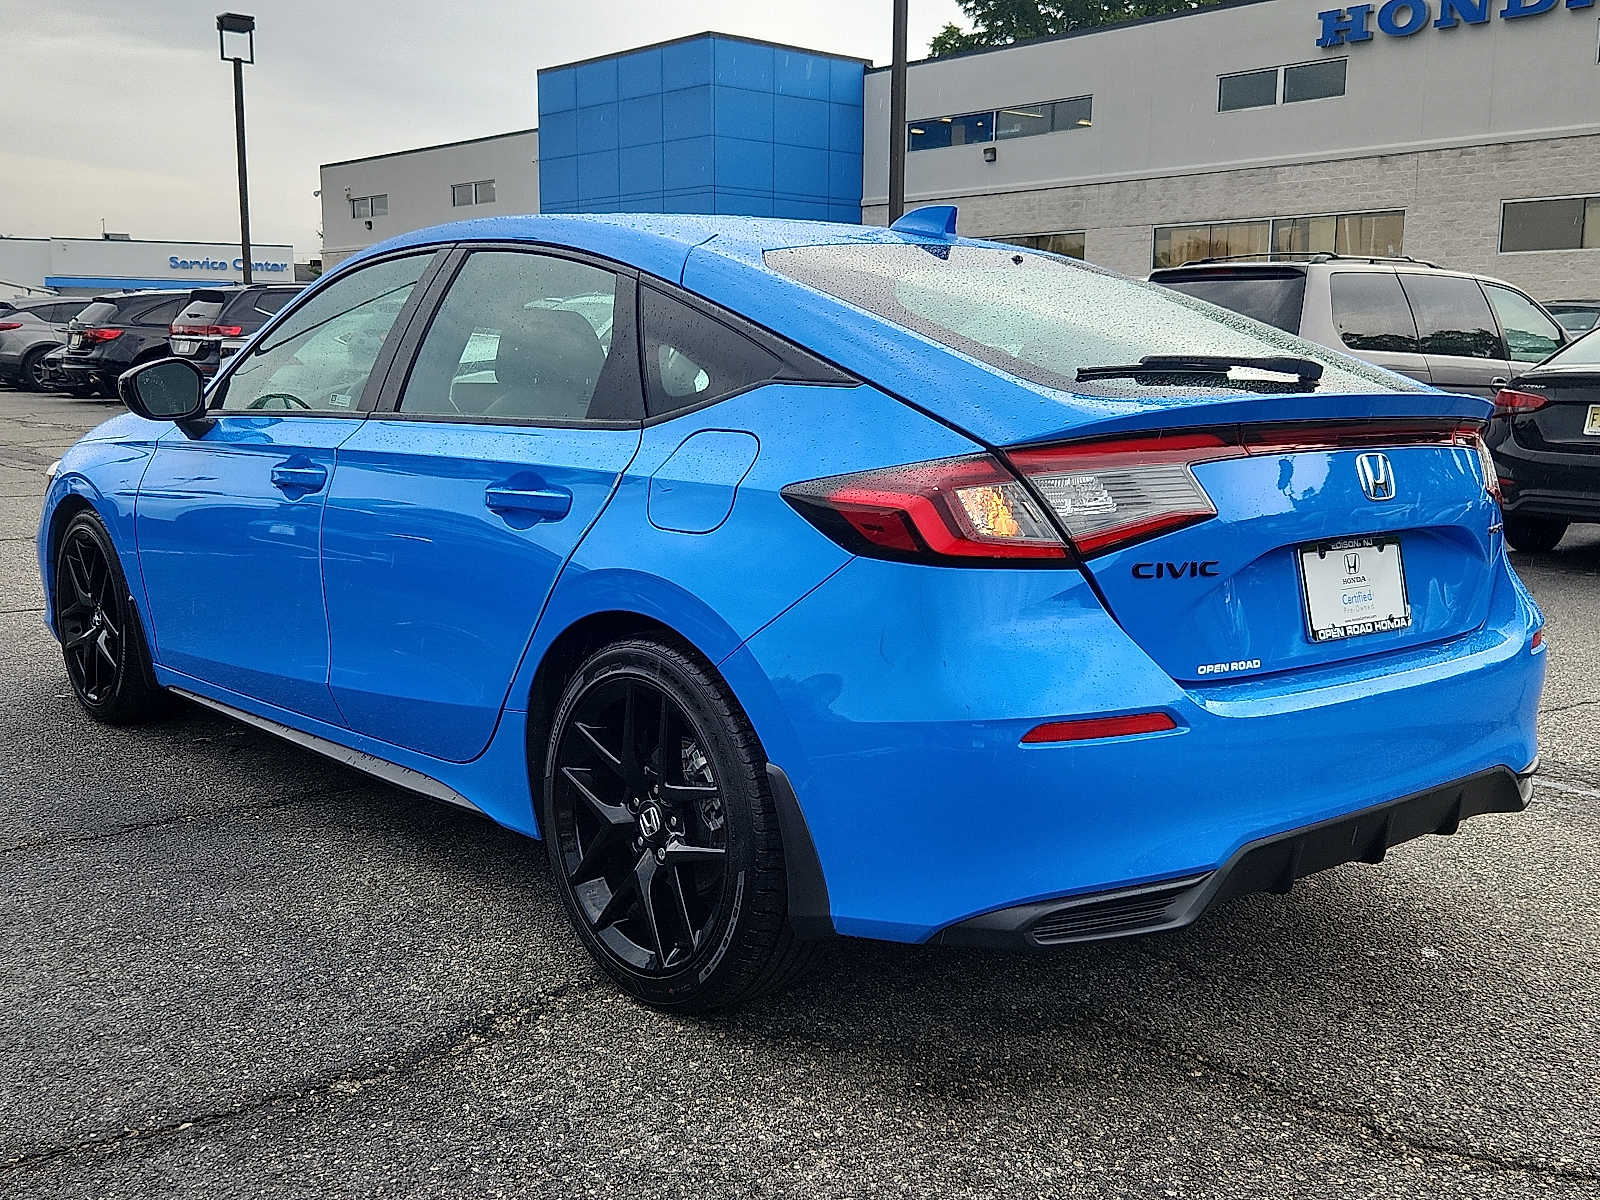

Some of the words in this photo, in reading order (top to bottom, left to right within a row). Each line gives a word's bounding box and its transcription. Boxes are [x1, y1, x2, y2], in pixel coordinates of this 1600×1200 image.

[1315, 0, 1596, 47] HON
[168, 256, 228, 271] Service
[232, 258, 288, 272] Cnter
[1362, 538, 1373, 546] NJ
[1132, 560, 1219, 579] CIVIC
[1342, 576, 1366, 584] HONDA
[1342, 590, 1372, 605] Certified
[1318, 627, 1345, 640] OPEN
[1346, 622, 1373, 636] ROAD
[1374, 617, 1407, 633] HONDA
[1197, 663, 1229, 675] OPEN
[1230, 659, 1261, 672] ROAD
